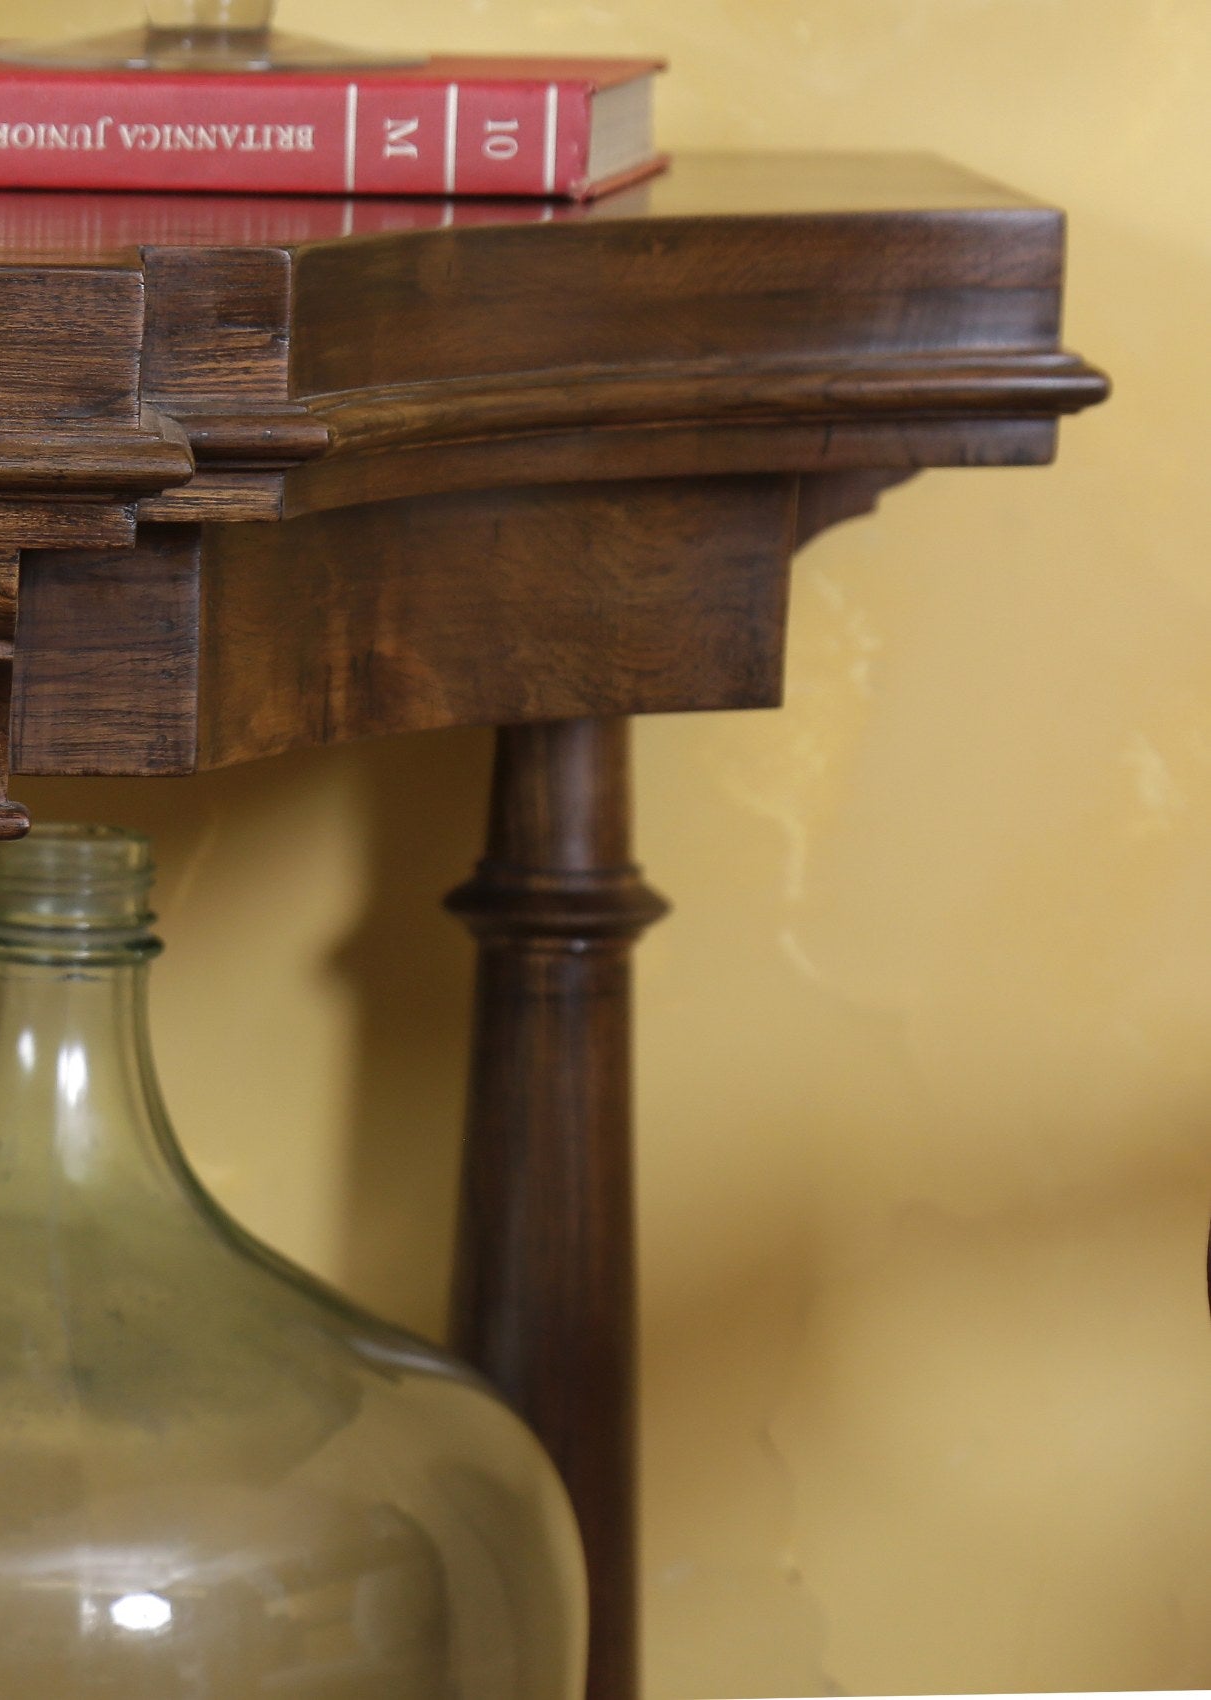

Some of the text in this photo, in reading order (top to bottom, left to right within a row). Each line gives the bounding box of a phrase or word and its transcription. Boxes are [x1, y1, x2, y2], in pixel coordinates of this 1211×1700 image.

[118, 123, 316, 152] BRITANNICA
[382, 117, 420, 160] M
[480, 118, 520, 161] 10
